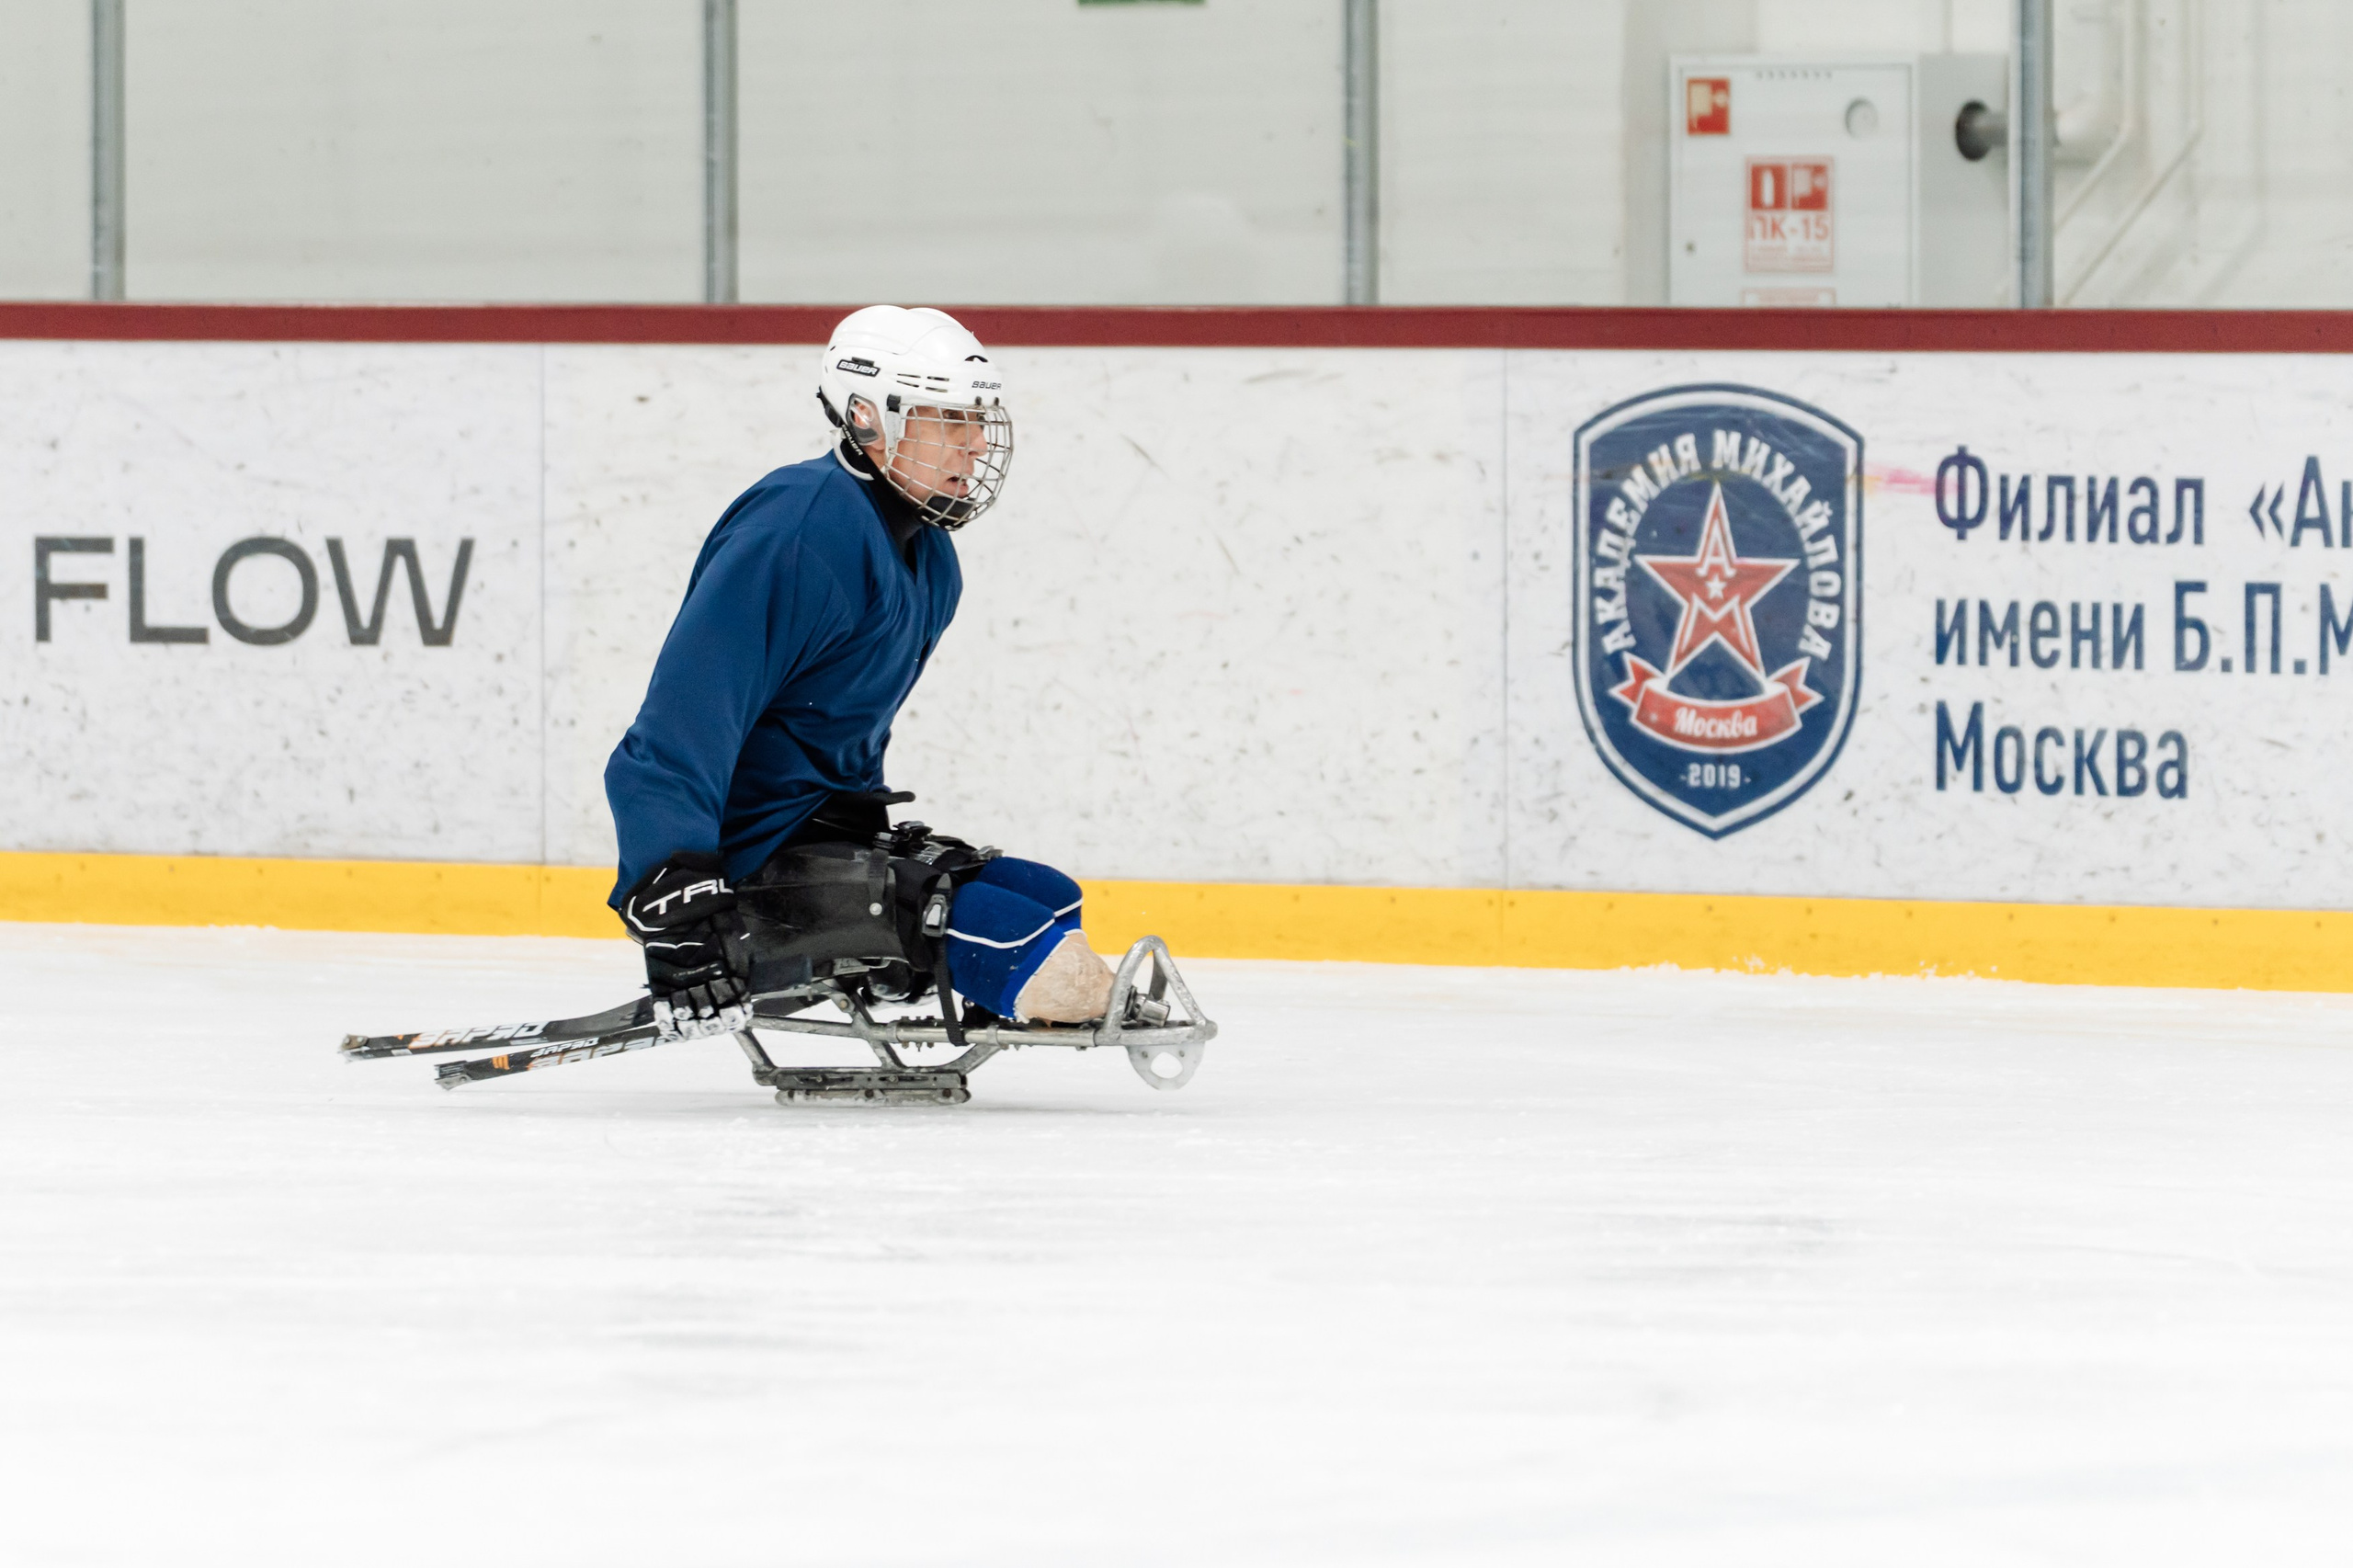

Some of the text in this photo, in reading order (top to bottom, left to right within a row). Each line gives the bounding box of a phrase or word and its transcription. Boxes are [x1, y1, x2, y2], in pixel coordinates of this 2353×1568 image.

[838, 360, 879, 375] BAUER
[972, 381, 1002, 390] BAUER
[1936, 445, 2205, 545] Филиал
[1594, 429, 1841, 660] АКАДЕМИЯ МИХАЙЛОВА
[35, 537, 475, 646] FLOW
[1936, 599, 2144, 670] имени
[1674, 707, 1757, 738] Москва
[1936, 700, 2188, 800] Москва
